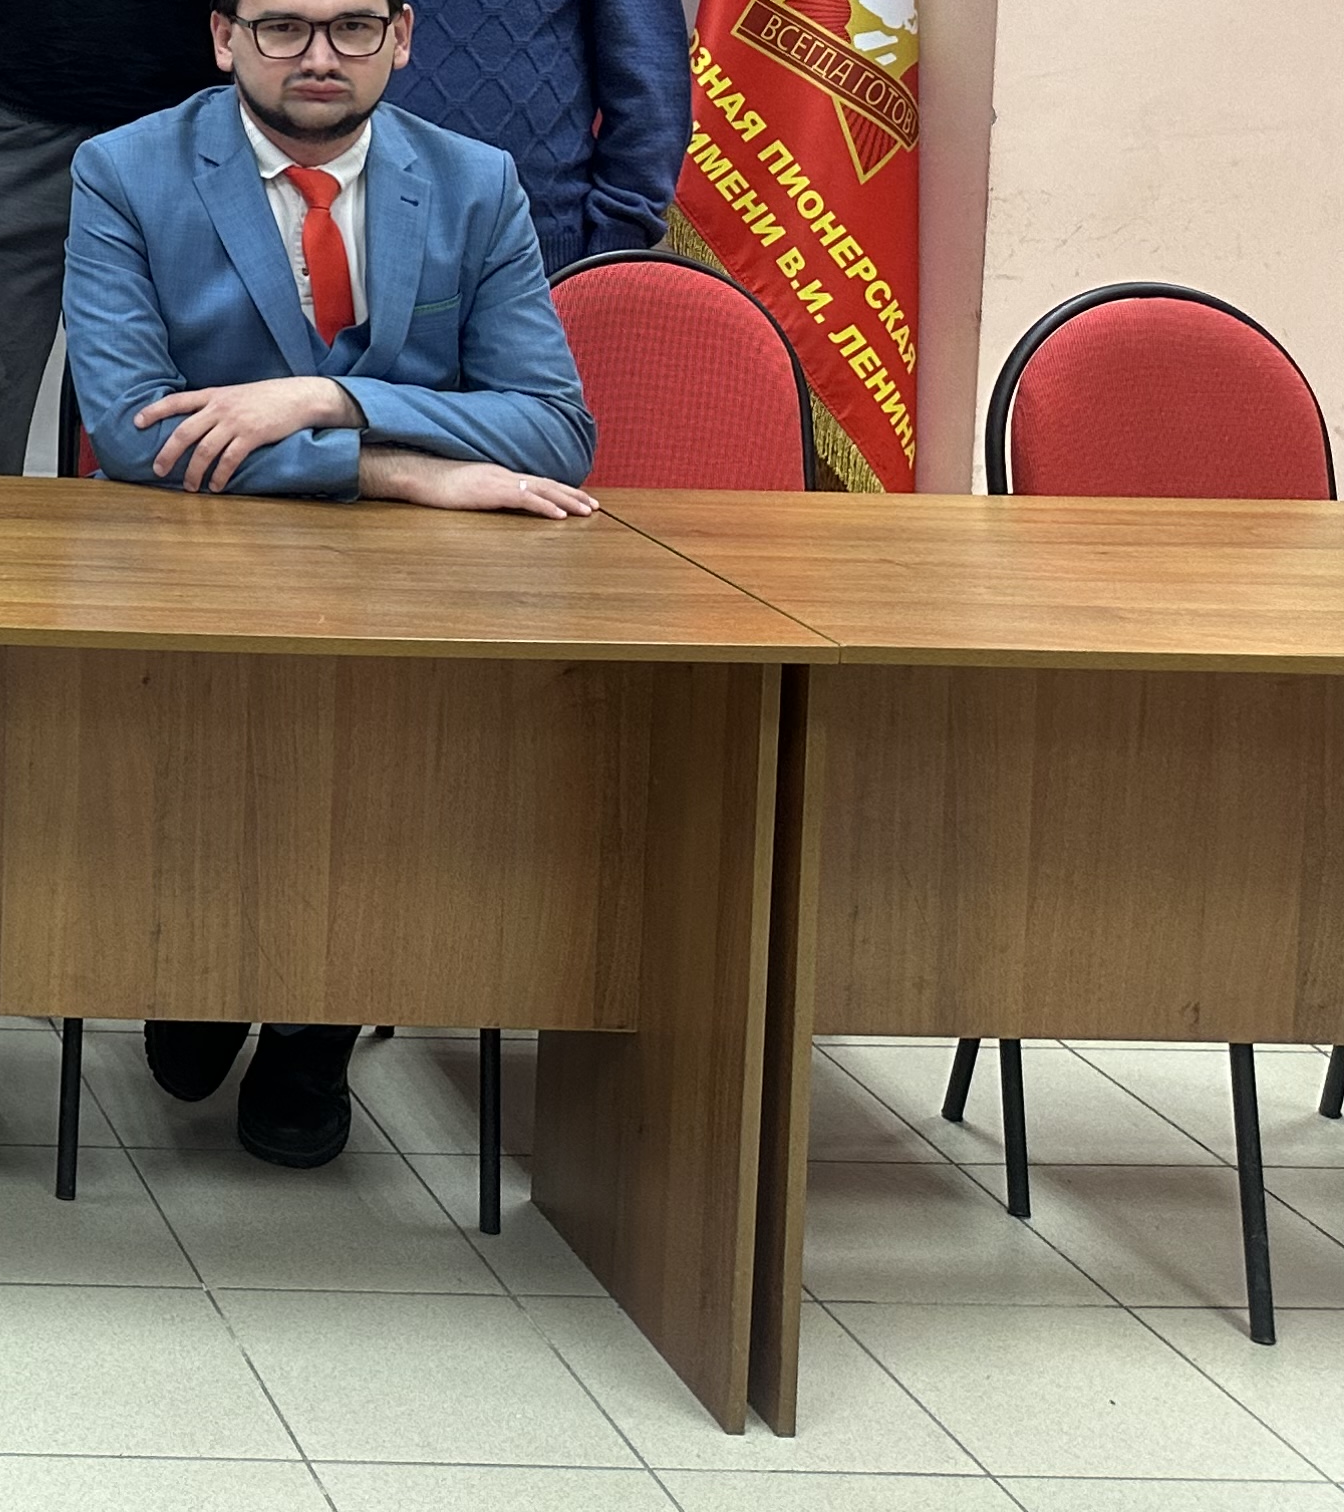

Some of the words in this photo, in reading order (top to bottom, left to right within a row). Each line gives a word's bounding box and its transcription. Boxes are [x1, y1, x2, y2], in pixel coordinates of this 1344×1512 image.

[760, 14, 854, 88] ВСЕГДА
[757, 139, 916, 375] ПИОНЕРСКАЯ
[776, 246, 834, 325] В.И.
[827, 324, 917, 470] ЛЕНИНА
